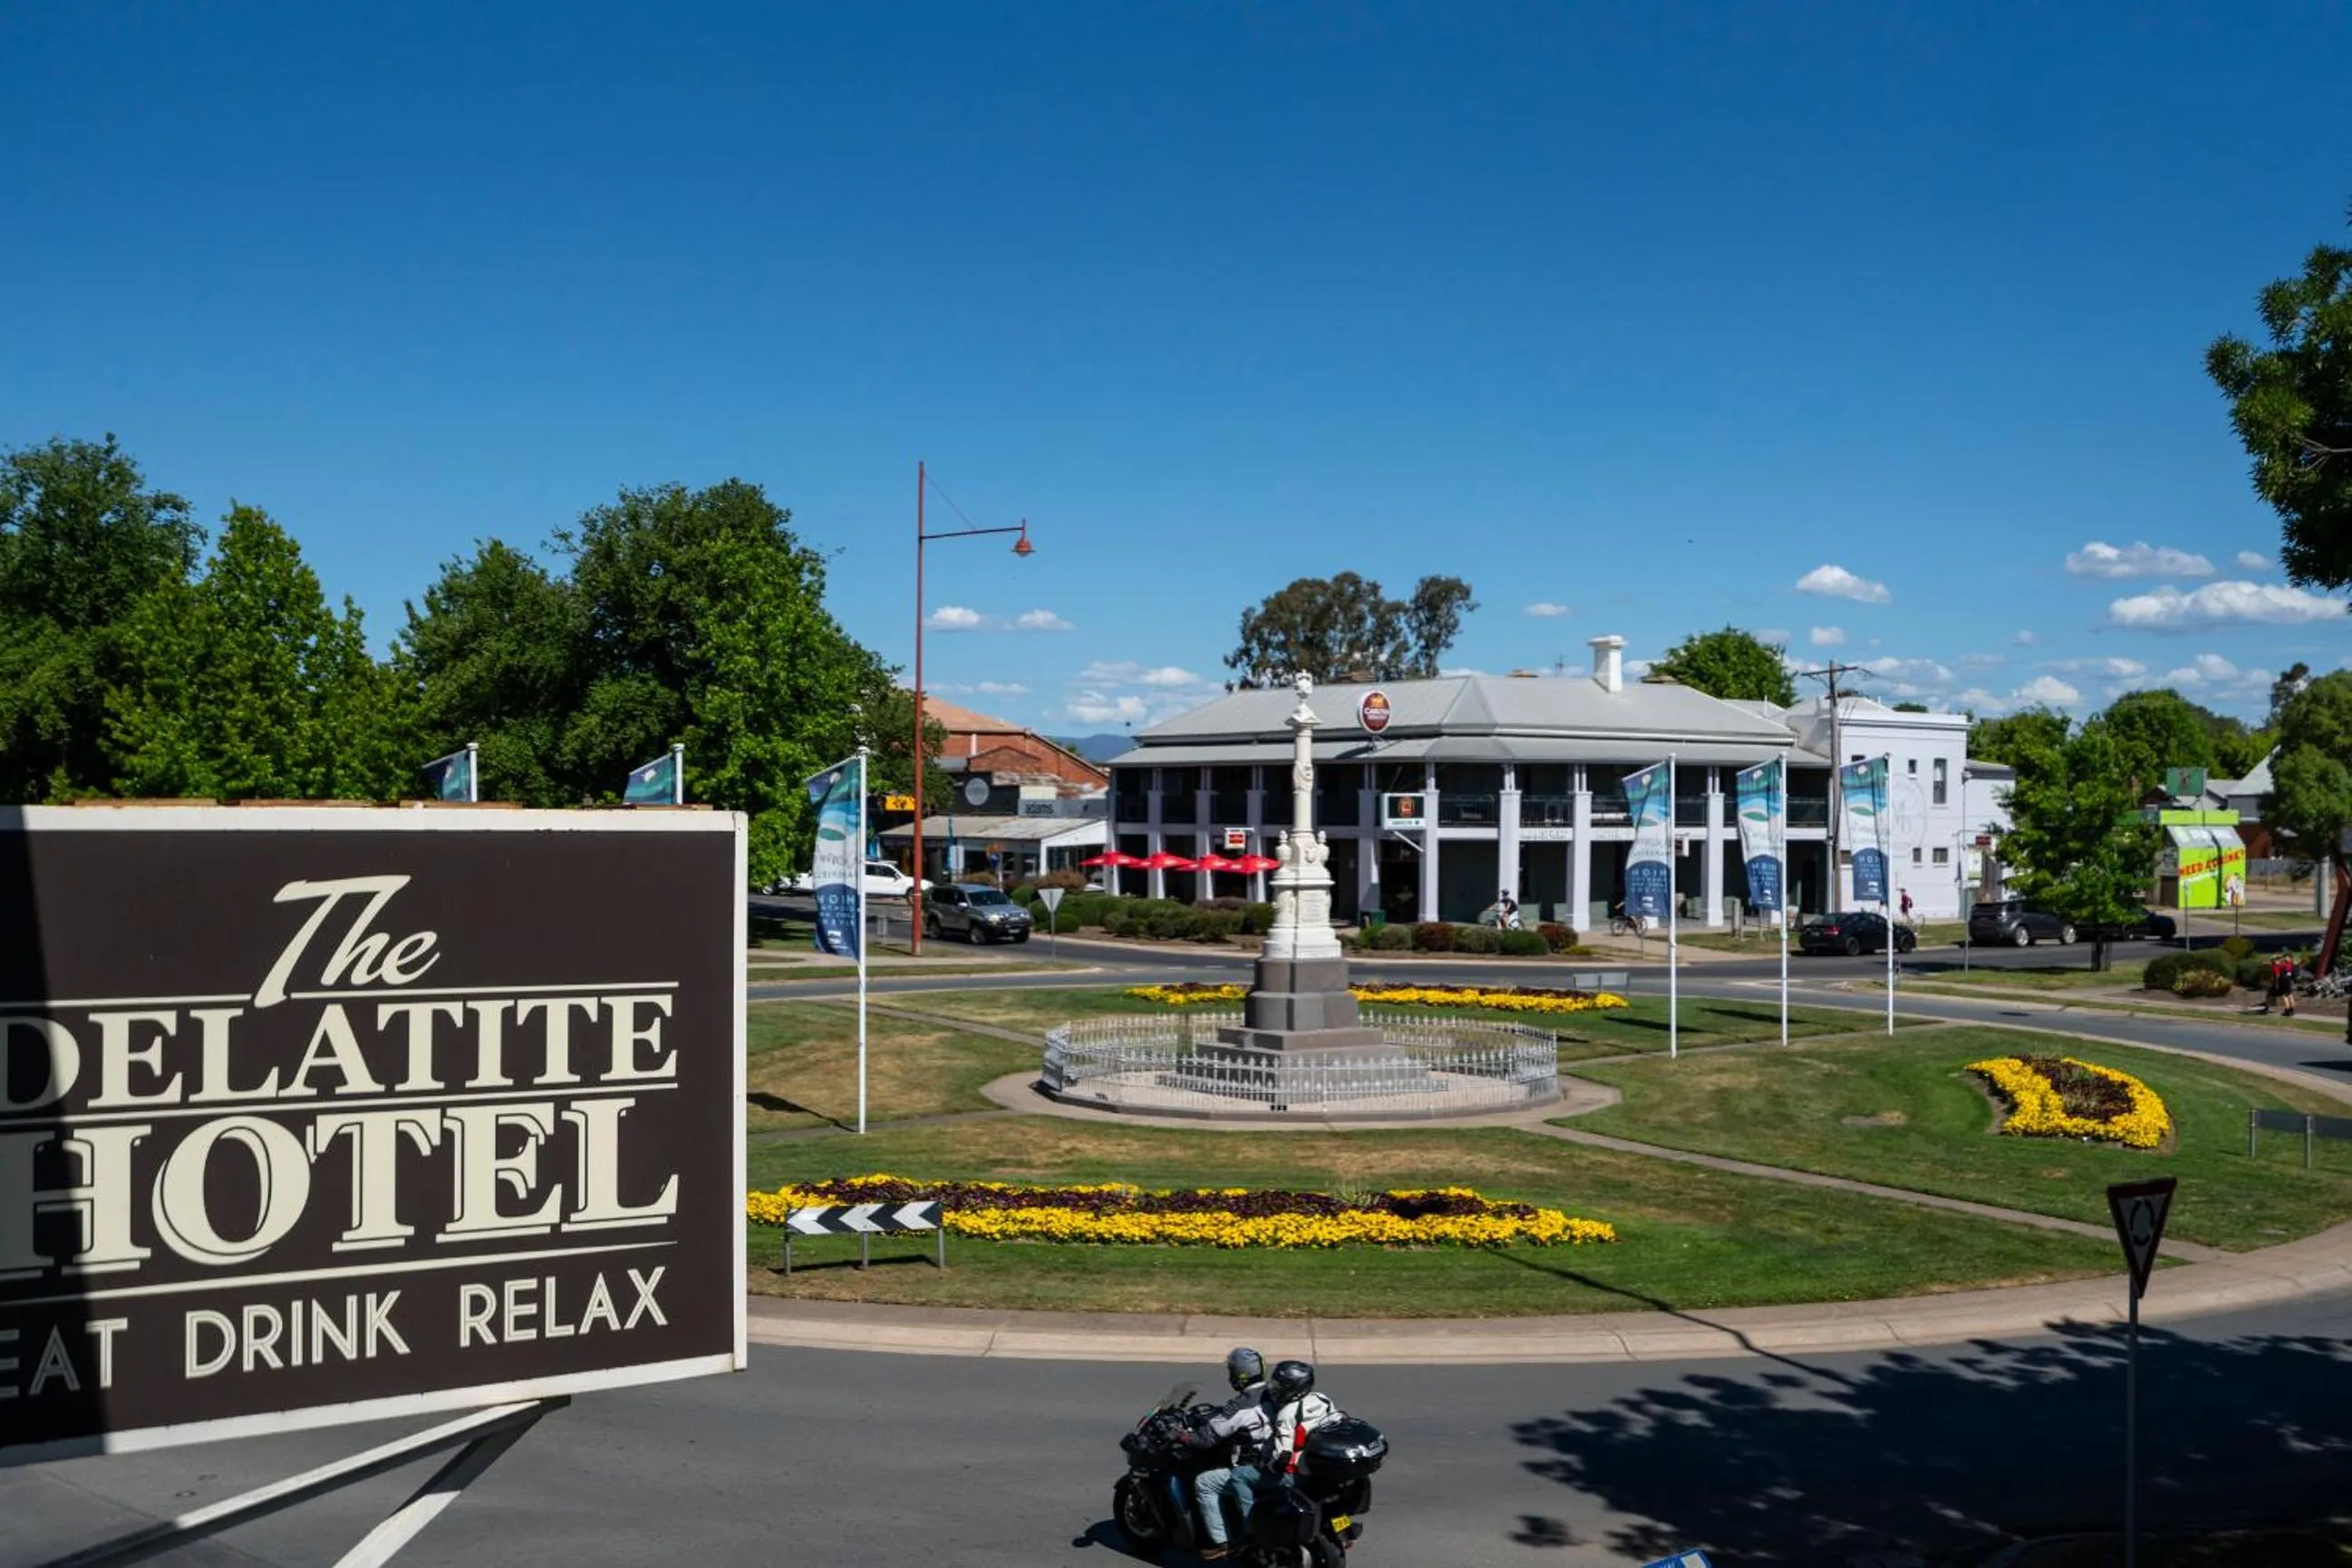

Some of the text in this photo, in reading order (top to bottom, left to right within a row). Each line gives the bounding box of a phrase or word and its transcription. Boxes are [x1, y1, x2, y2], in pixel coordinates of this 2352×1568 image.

[254, 875, 440, 1009] The
[0, 993, 678, 1112] DELATITE
[0, 1098, 678, 1279] HOTEL
[0, 1266, 669, 1399] EAT DRINK RELAX
